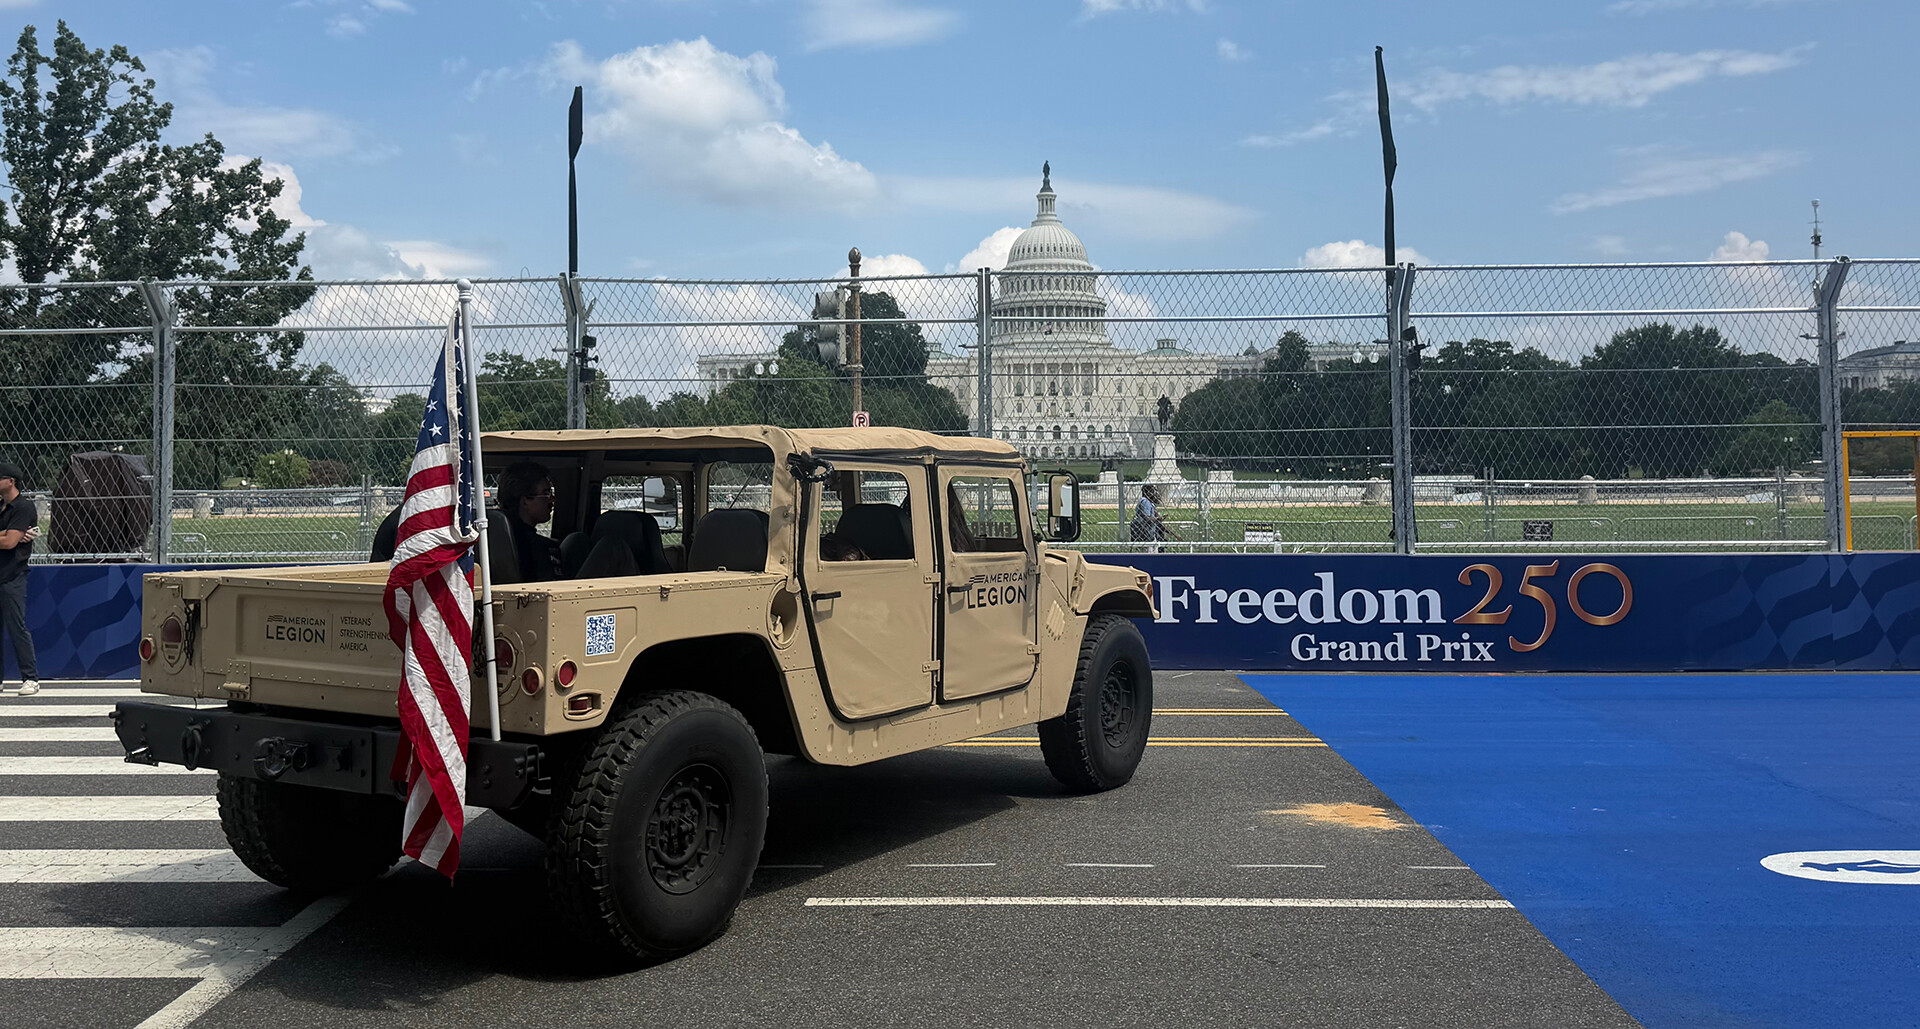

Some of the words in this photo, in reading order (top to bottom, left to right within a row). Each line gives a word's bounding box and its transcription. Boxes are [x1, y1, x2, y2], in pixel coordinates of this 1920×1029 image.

[984, 572, 1028, 584] AMERICAN
[967, 585, 1027, 609] LEGION
[1153, 571, 1446, 624] Freedom
[1453, 559, 1633, 653] 250
[283, 616, 326, 626] AMERICAN
[340, 616, 371, 626] VETERANS
[266, 625, 325, 643] LEGION
[339, 642, 368, 652] AMERICA
[1291, 632, 1408, 661] Grand
[1416, 633, 1495, 662] Prix
